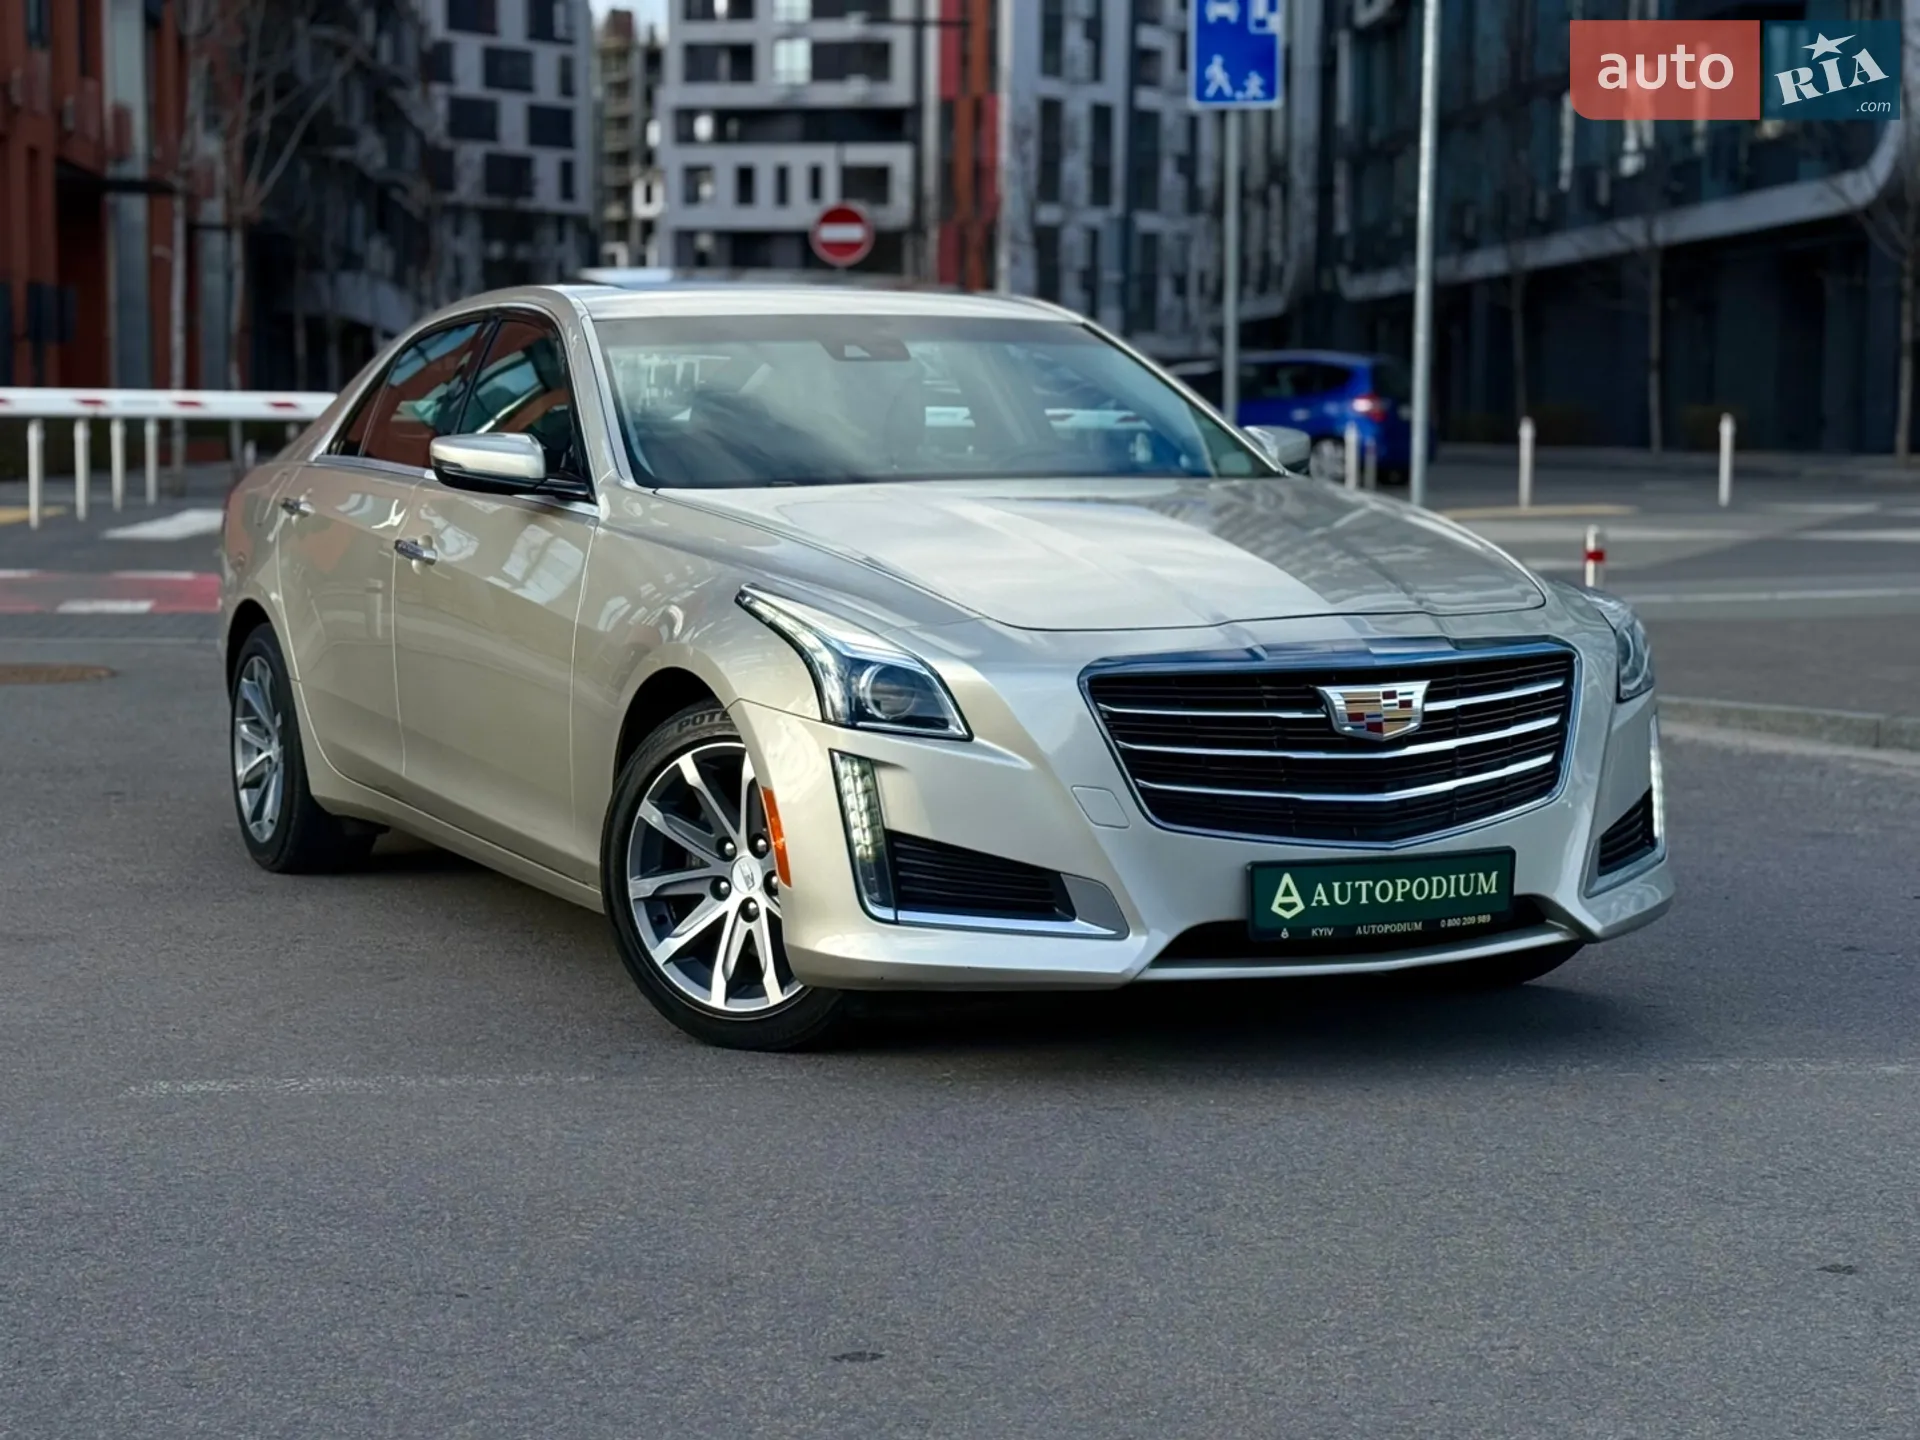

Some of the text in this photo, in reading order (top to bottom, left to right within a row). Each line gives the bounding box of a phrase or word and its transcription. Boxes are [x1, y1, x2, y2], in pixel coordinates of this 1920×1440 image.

[1311, 871, 1499, 906] AUTOPODIUM
[1311, 927, 1334, 937] KYIV
[1355, 921, 1423, 935] AUTOPODIUM
